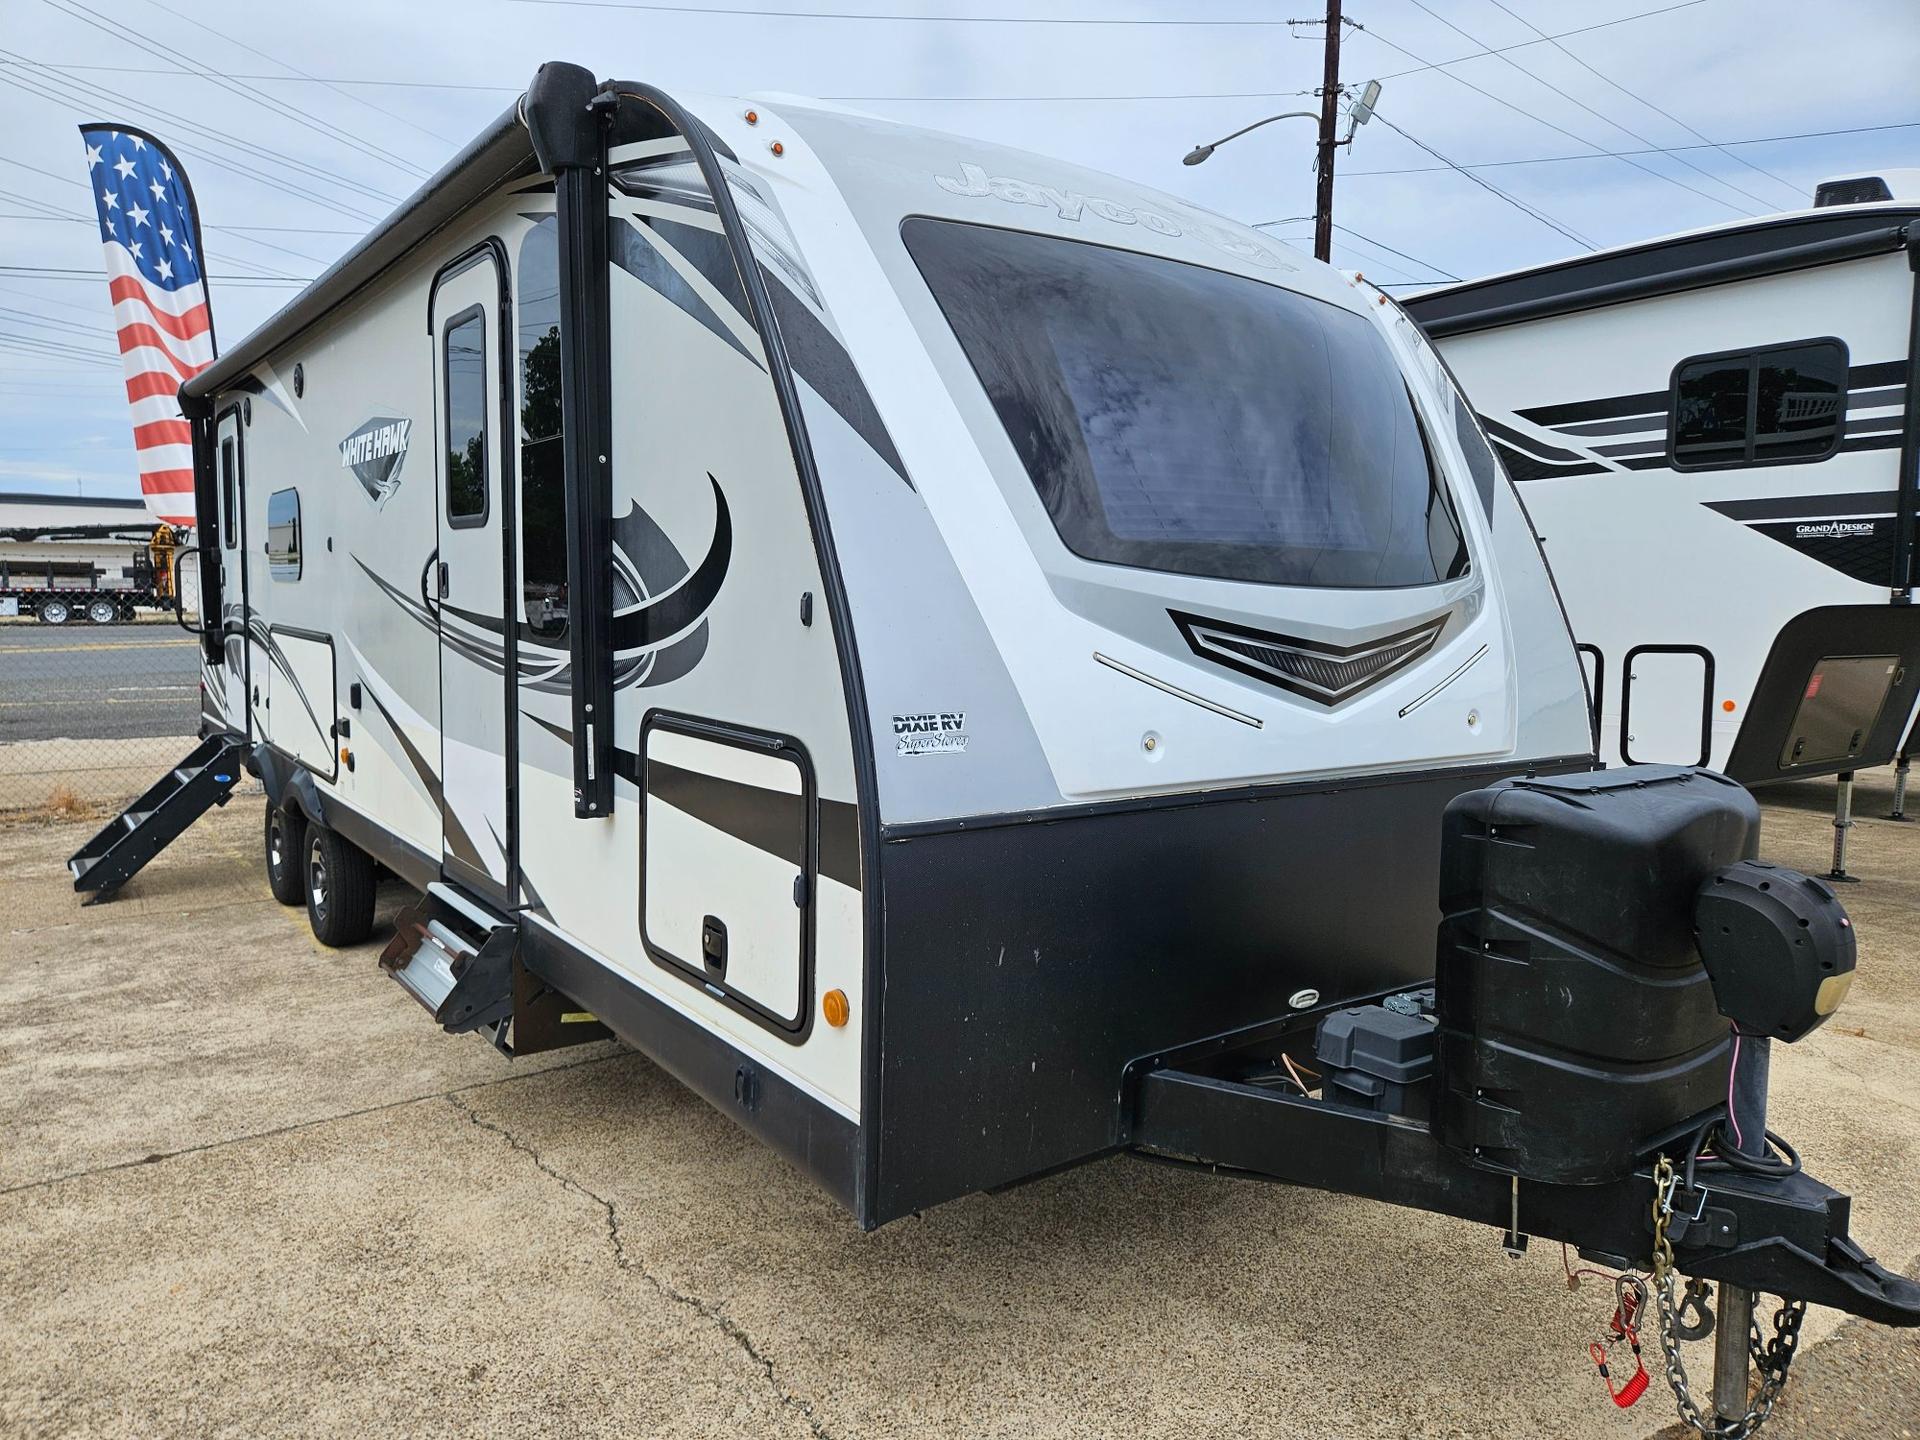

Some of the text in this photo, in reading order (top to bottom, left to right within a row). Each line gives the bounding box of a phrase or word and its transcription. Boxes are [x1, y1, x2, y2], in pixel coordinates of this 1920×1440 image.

[933, 161, 1183, 238] Jayco
[341, 419, 410, 468] WHITE HAWK
[1795, 523, 1874, 533] GRAND DESIGN
[892, 713, 964, 734] DIXIE RV
